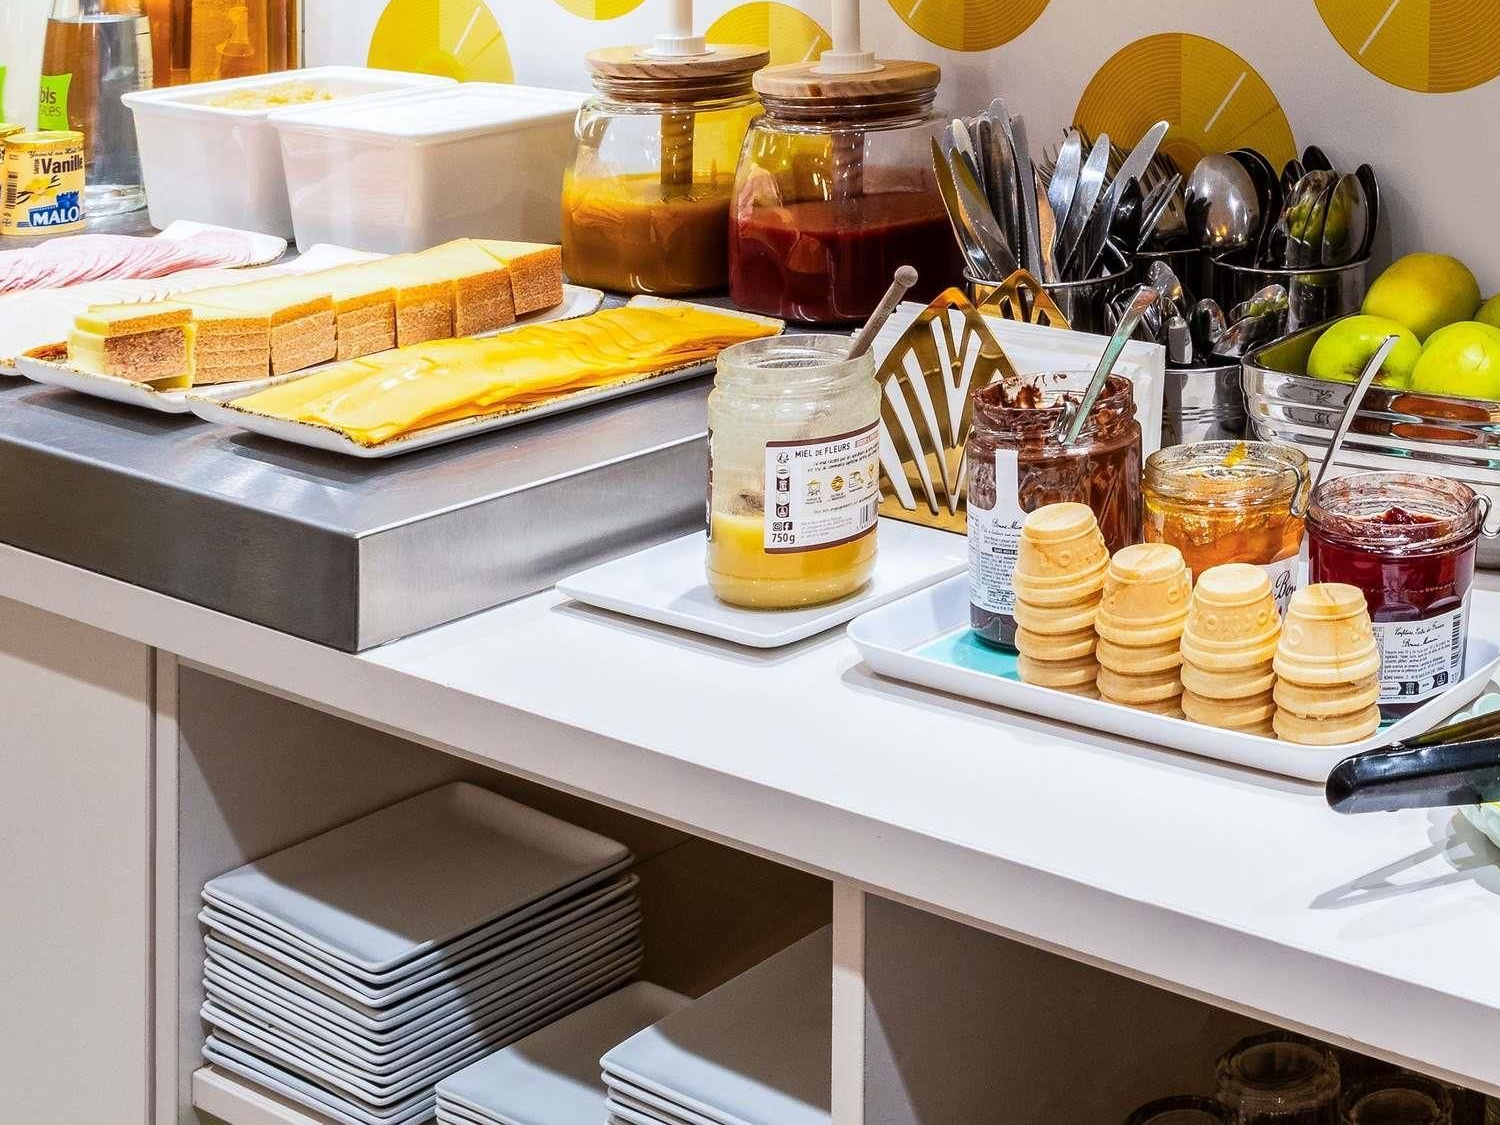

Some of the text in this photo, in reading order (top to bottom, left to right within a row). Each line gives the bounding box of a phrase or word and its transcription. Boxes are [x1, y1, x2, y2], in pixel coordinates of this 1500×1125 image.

[32, 206, 80, 227] MALO
[794, 449, 812, 459] MIEL
[824, 442, 851, 456] FLEURS
